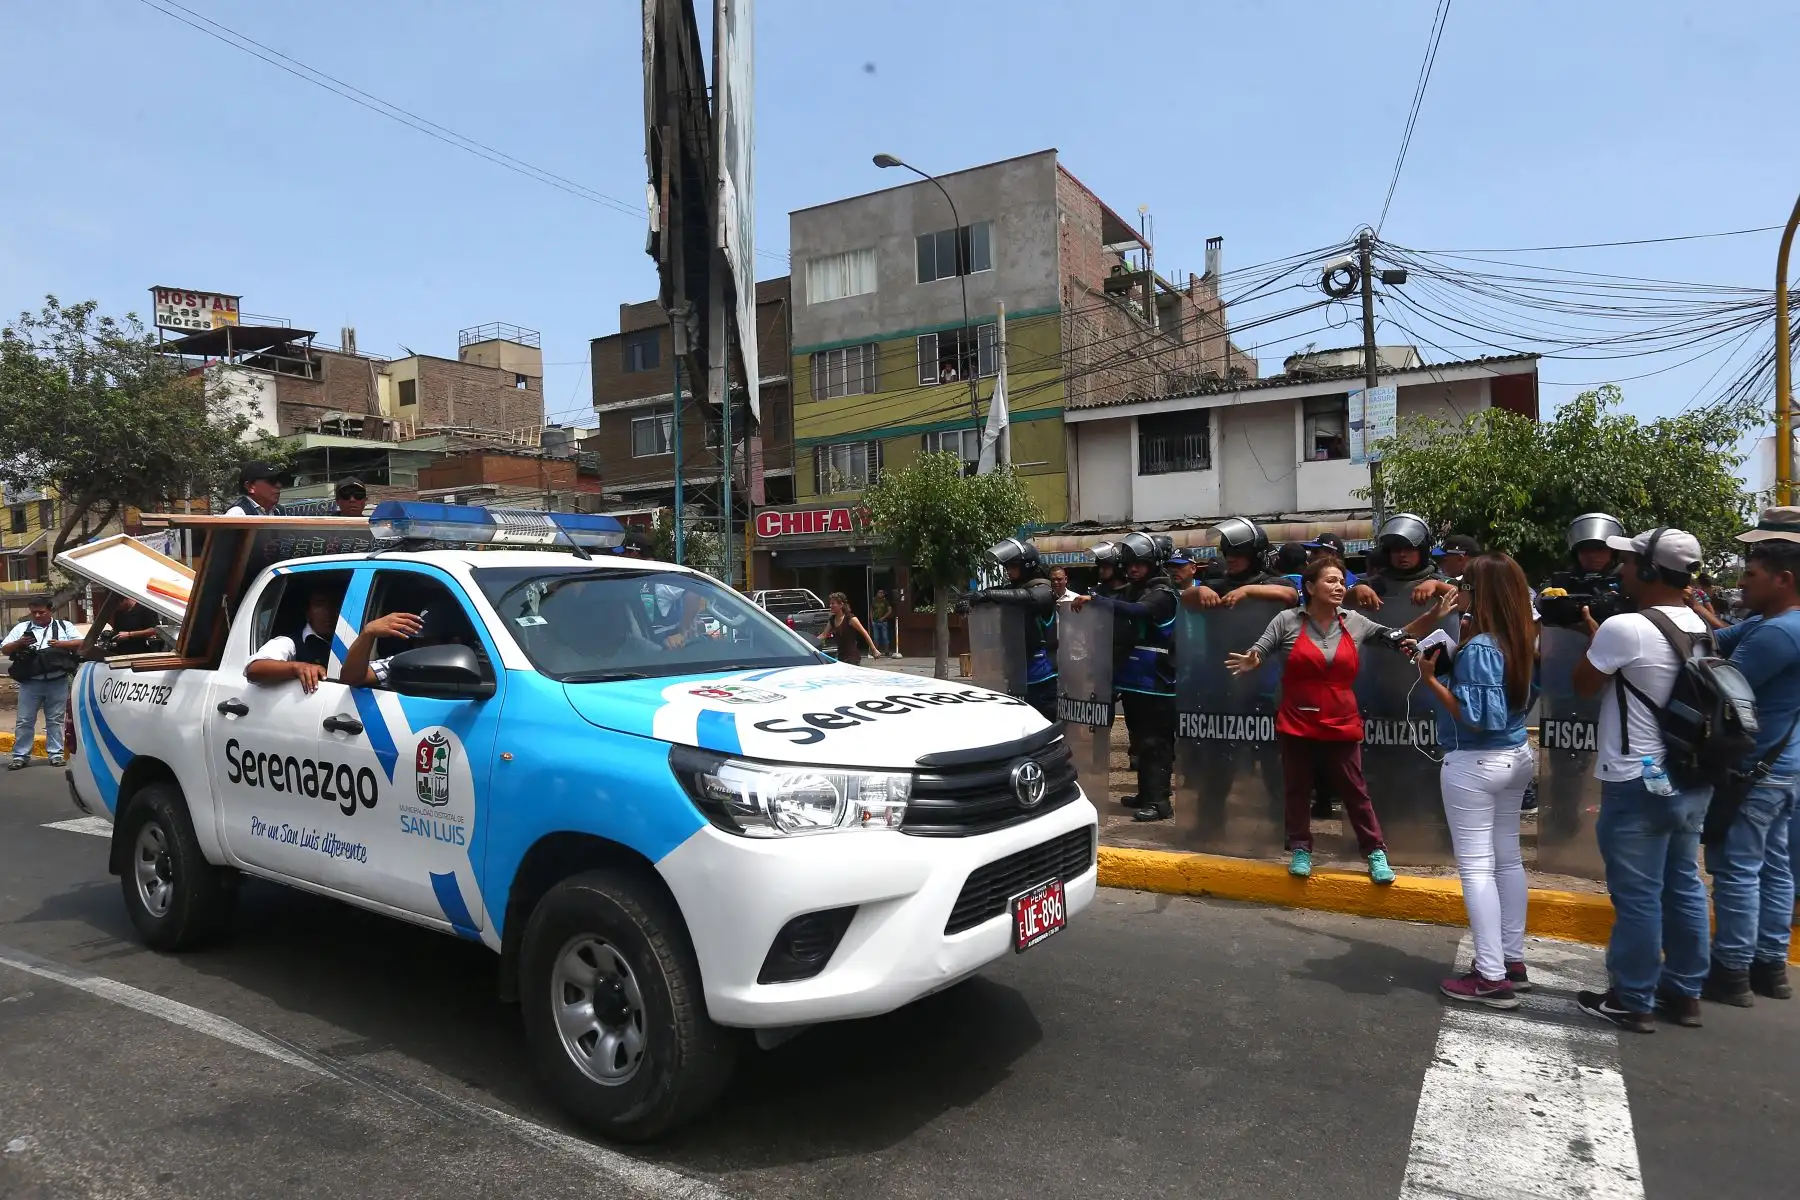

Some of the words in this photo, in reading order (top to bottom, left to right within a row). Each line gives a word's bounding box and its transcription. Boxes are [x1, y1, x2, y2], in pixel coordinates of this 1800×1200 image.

[157, 289, 237, 312] HOSTAL
[168, 305, 200, 317] Las
[158, 315, 211, 328] Moras
[756, 508, 853, 538] CHIFA
[110, 680, 130, 705] (01)
[127, 682, 173, 706] 250-1152
[1057, 697, 1109, 727] FISCALIZACION
[1362, 718, 1441, 746] CALIZACI
[1544, 719, 1599, 751] FISCA
[225, 738, 379, 817] Serenazgo
[251, 815, 267, 836] Por
[267, 824, 279, 841] un
[280, 824, 299, 846] San
[300, 827, 320, 851] Luis
[321, 832, 368, 864] diferente
[400, 815, 431, 838] SAN
[433, 821, 465, 846] LUIS
[1024, 892, 1062, 937] UE-896
